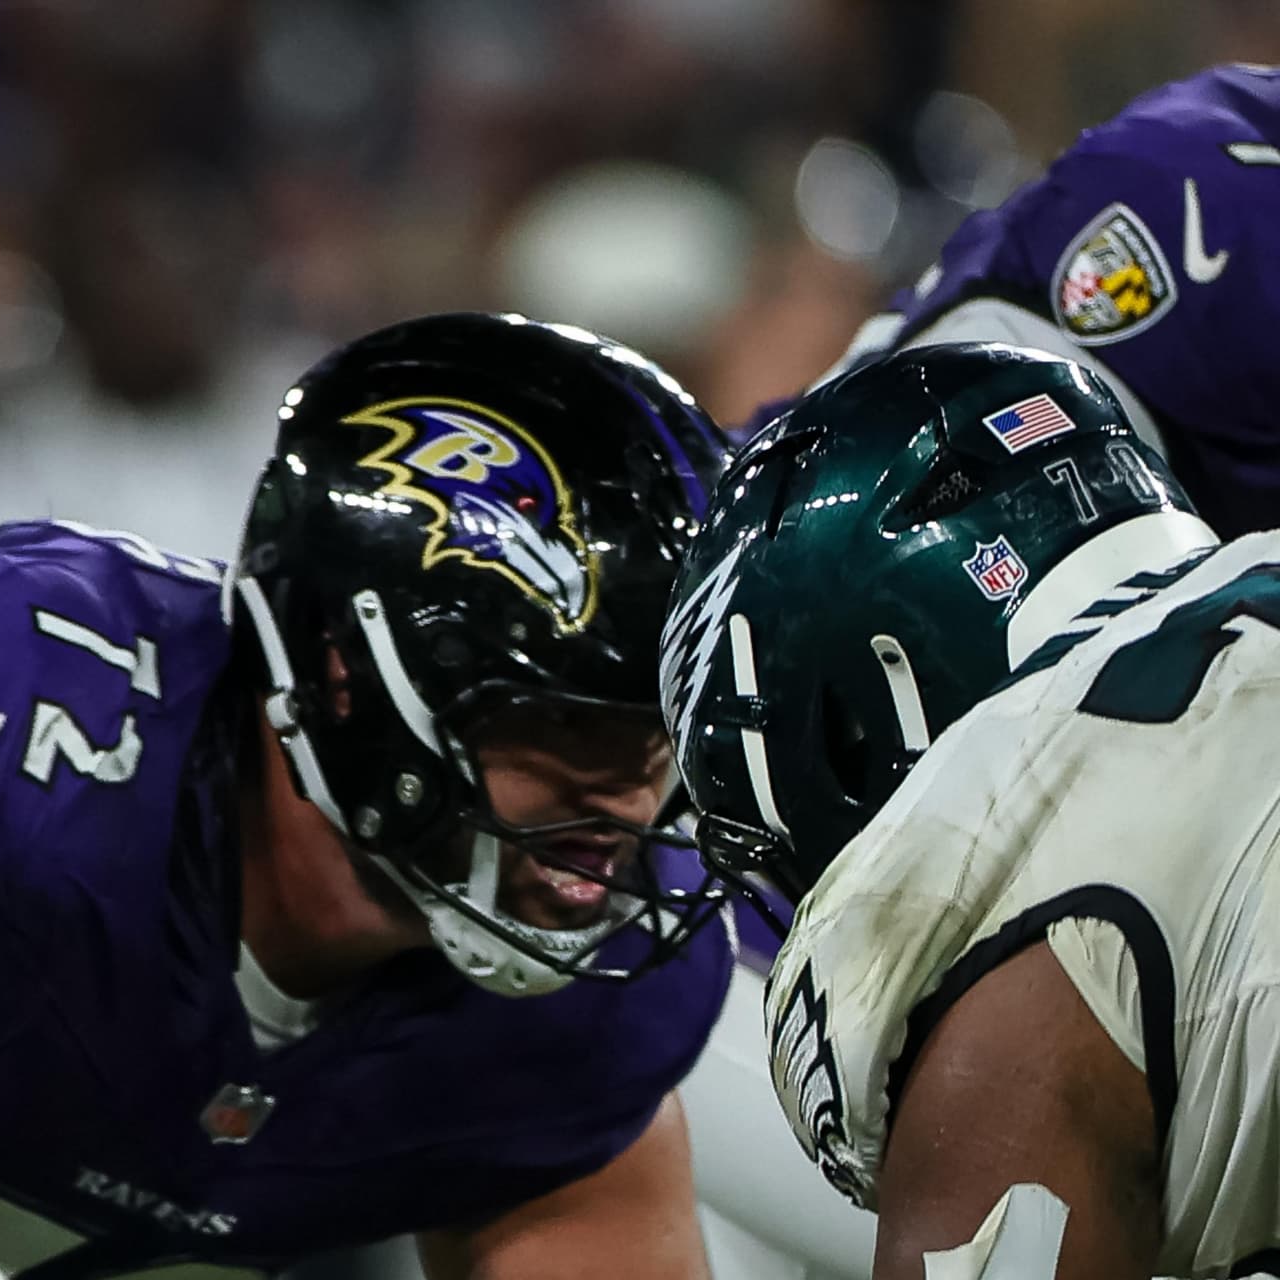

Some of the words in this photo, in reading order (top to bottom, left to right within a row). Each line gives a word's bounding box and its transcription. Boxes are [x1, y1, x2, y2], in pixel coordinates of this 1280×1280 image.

[404, 410, 520, 483] B
[982, 560, 1021, 593] NFL
[22, 609, 162, 784] 72
